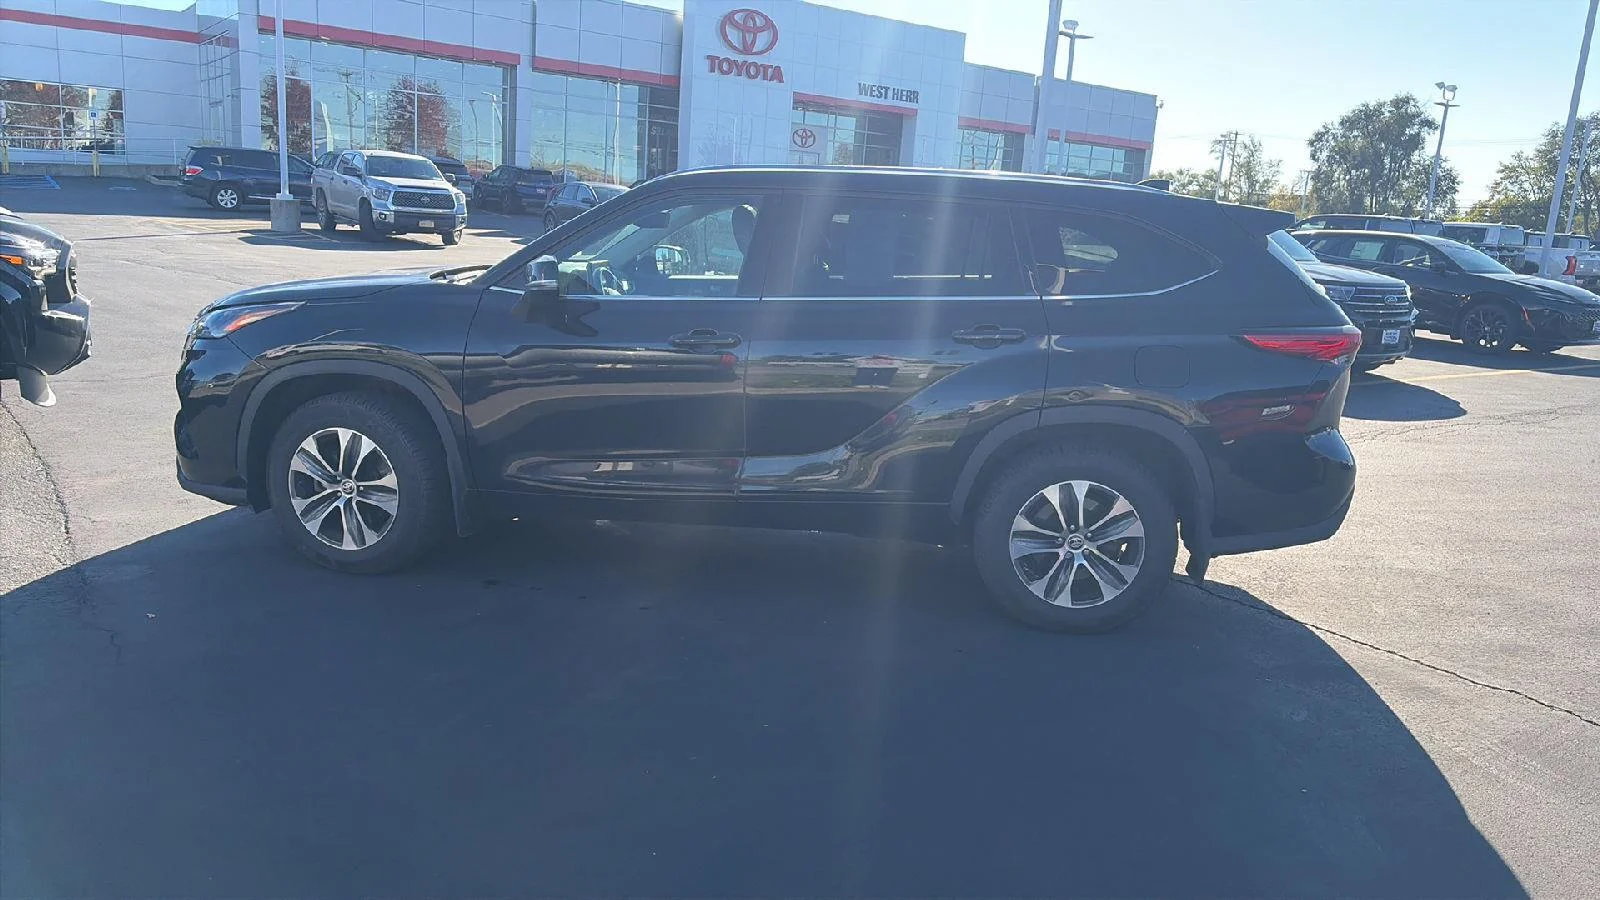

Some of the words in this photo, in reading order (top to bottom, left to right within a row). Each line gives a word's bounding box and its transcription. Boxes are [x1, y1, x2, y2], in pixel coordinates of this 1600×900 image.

[706, 55, 785, 83] TOYOTA
[858, 82, 890, 100] WEST
[892, 87, 920, 104] HERR
